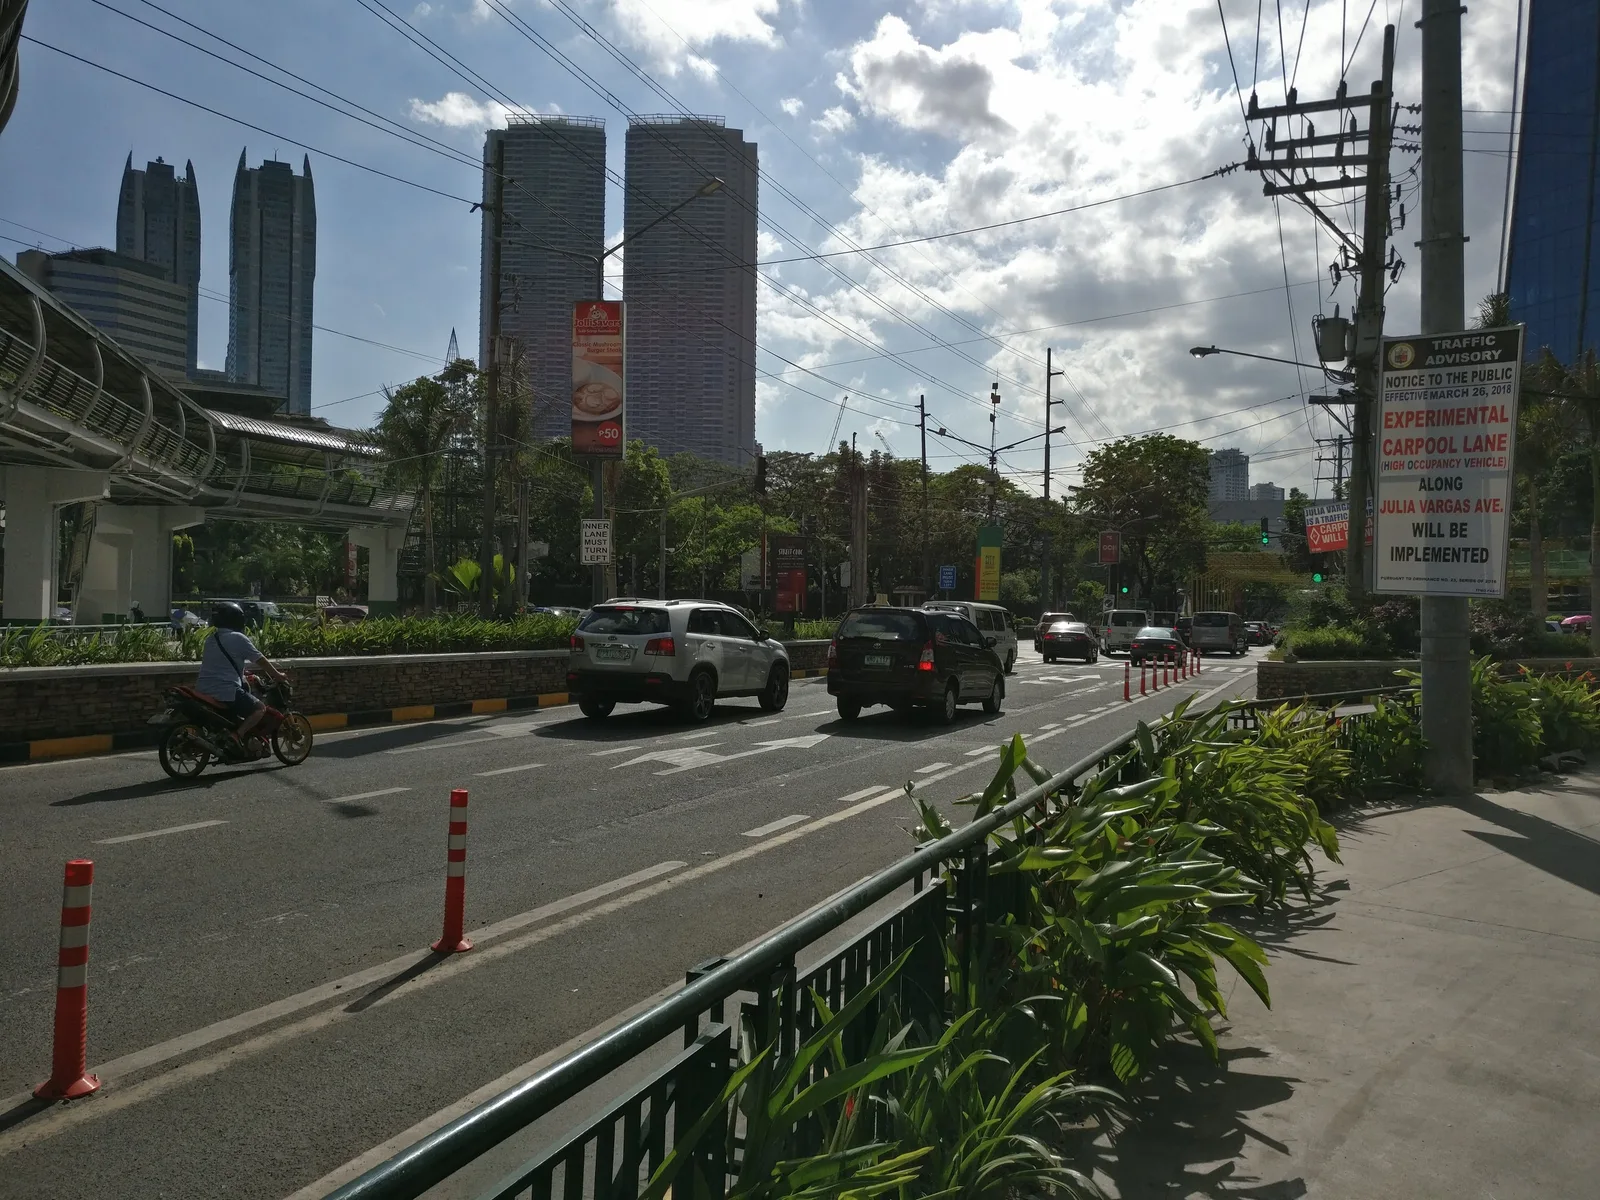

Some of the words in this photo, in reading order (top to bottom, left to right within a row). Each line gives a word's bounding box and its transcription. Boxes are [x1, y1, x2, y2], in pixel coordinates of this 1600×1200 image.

[574, 317, 622, 328] JolliSavers
[1432, 335, 1496, 350] TRAFFIC
[1425, 349, 1502, 366] ADVISORY
[1385, 374, 1425, 389] NOTICE
[1428, 373, 1443, 386] TO
[1446, 371, 1467, 385] THE
[1471, 367, 1513, 383] PUBLIC
[1384, 390, 1428, 402] EFFECTIVE
[1429, 388, 1469, 400] MARCH
[1472, 387, 1489, 398] 26,
[1491, 384, 1512, 396] 2018
[1384, 405, 1509, 429] EXPERIMENTAL
[1382, 436, 1457, 456] CARPOOL
[1463, 433, 1508, 453] LANE
[1380, 460, 1405, 472] (HIGH
[1407, 458, 1461, 470] OCCUPANCY
[1463, 456, 1507, 468] VEHICLE)
[1418, 476, 1463, 492] ALONG
[1305, 507, 1325, 516] JULIA
[1379, 500, 1415, 514] JULIA
[1419, 499, 1471, 514] VARGAS
[1474, 499, 1504, 513] AVE.
[1320, 513, 1348, 522] TRAFFIC
[1320, 522, 1349, 534] CARPO
[1411, 522, 1445, 538] WILL
[1449, 522, 1468, 538] BE
[1322, 534, 1344, 543] WILL
[1391, 546, 1490, 563] IMPLEMENTED
